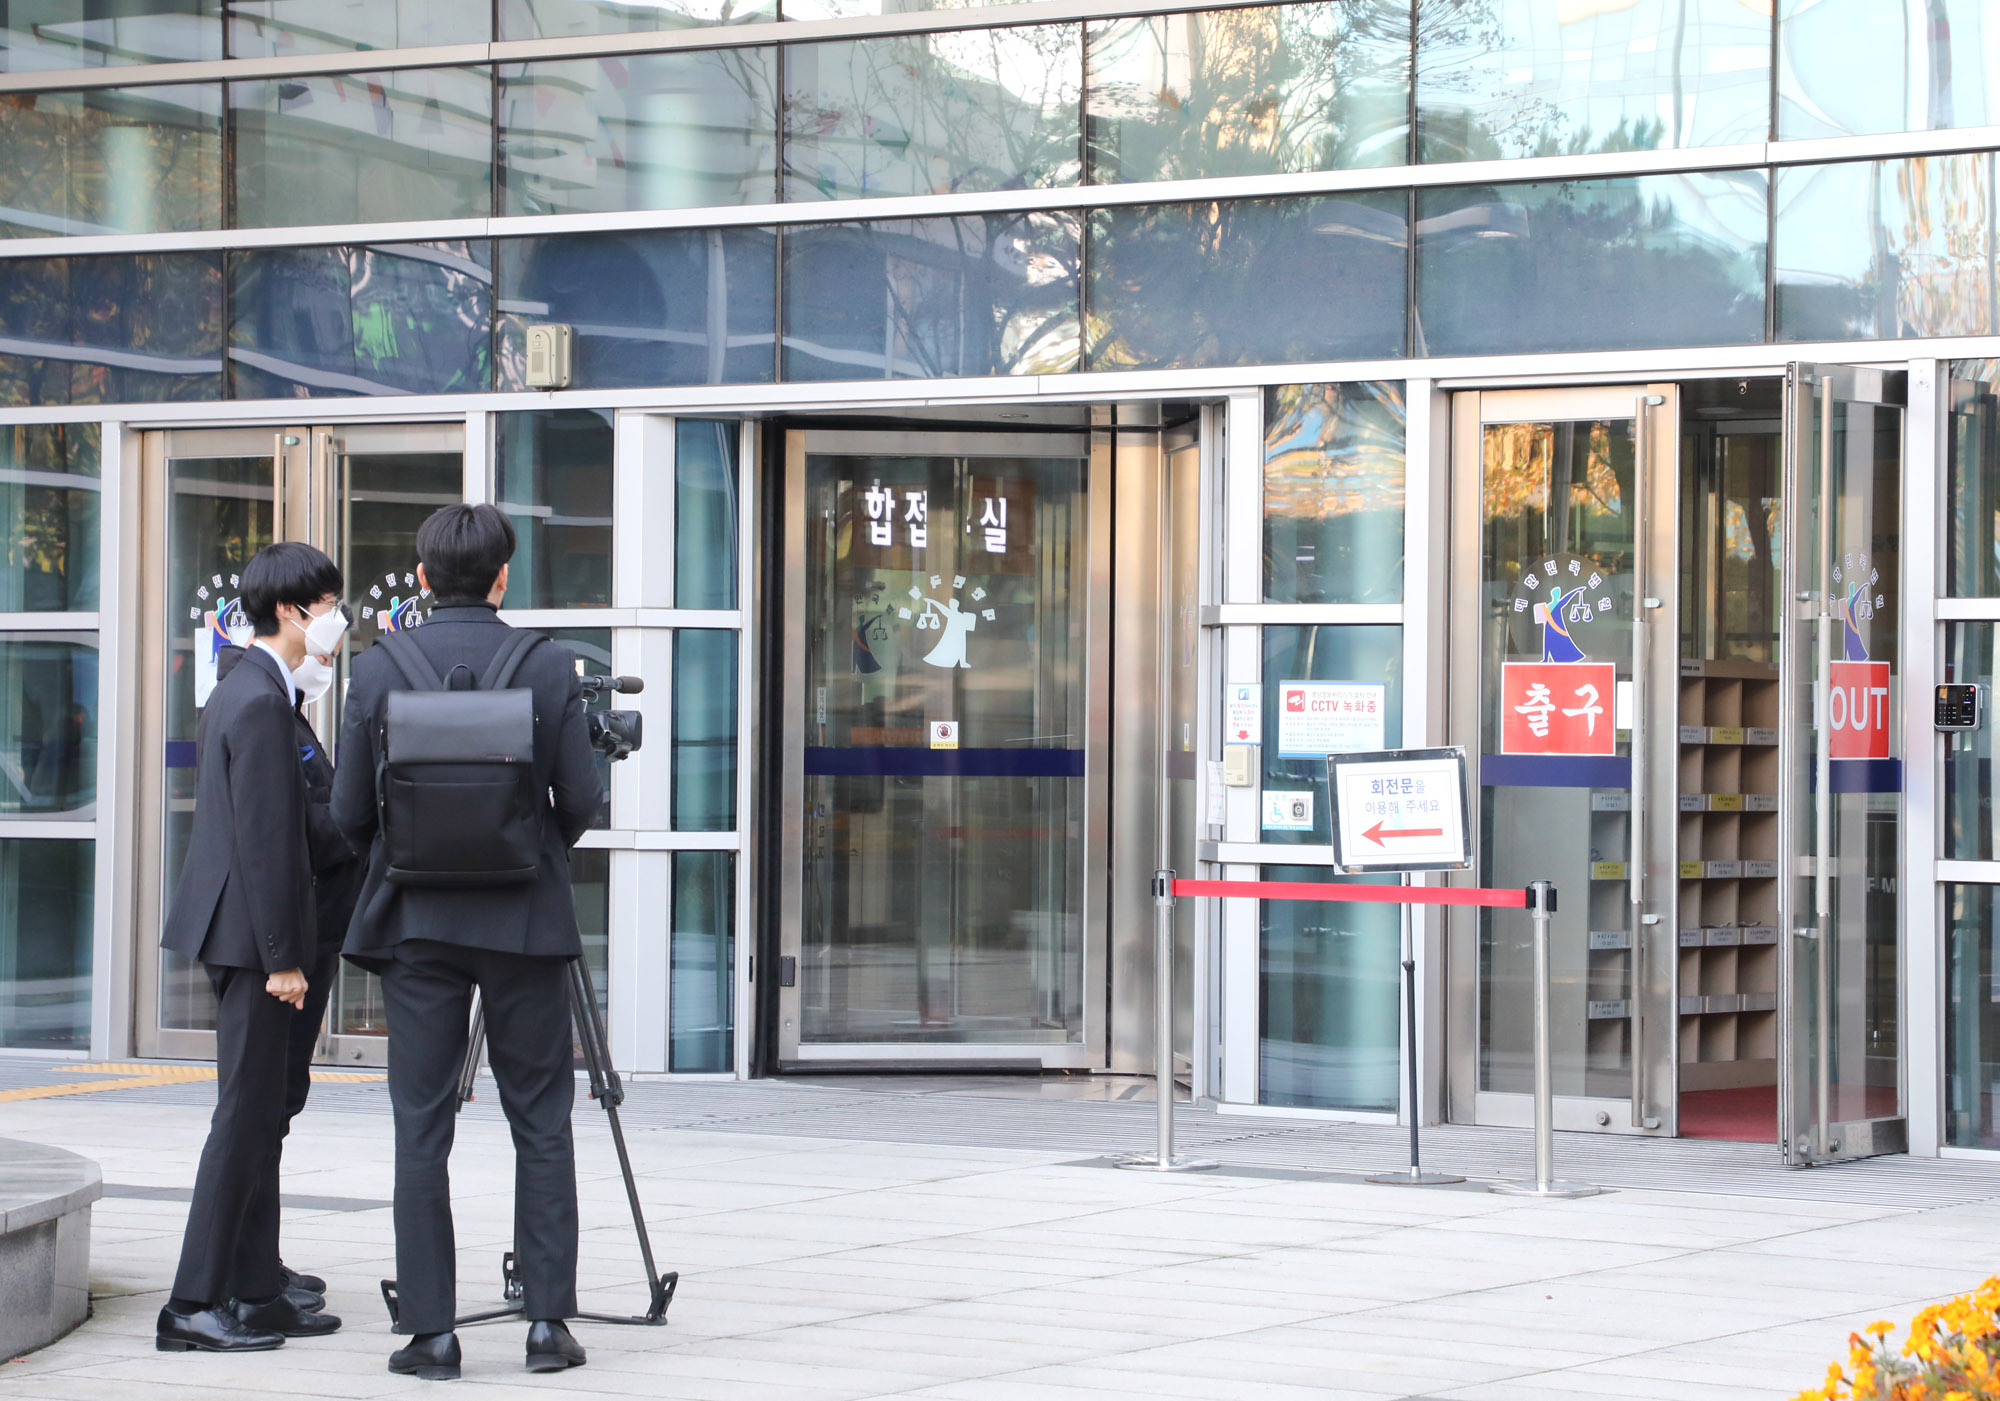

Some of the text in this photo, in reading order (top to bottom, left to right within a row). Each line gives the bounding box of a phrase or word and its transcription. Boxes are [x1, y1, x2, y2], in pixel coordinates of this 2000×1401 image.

[1311, 700, 1377, 713] CCTV 녹화중
[1514, 683, 1604, 737] 출구
[1829, 686, 1888, 731] OUT
[1371, 778, 1425, 795] 회전문을
[1365, 799, 1440, 815] 이용해 주세요
